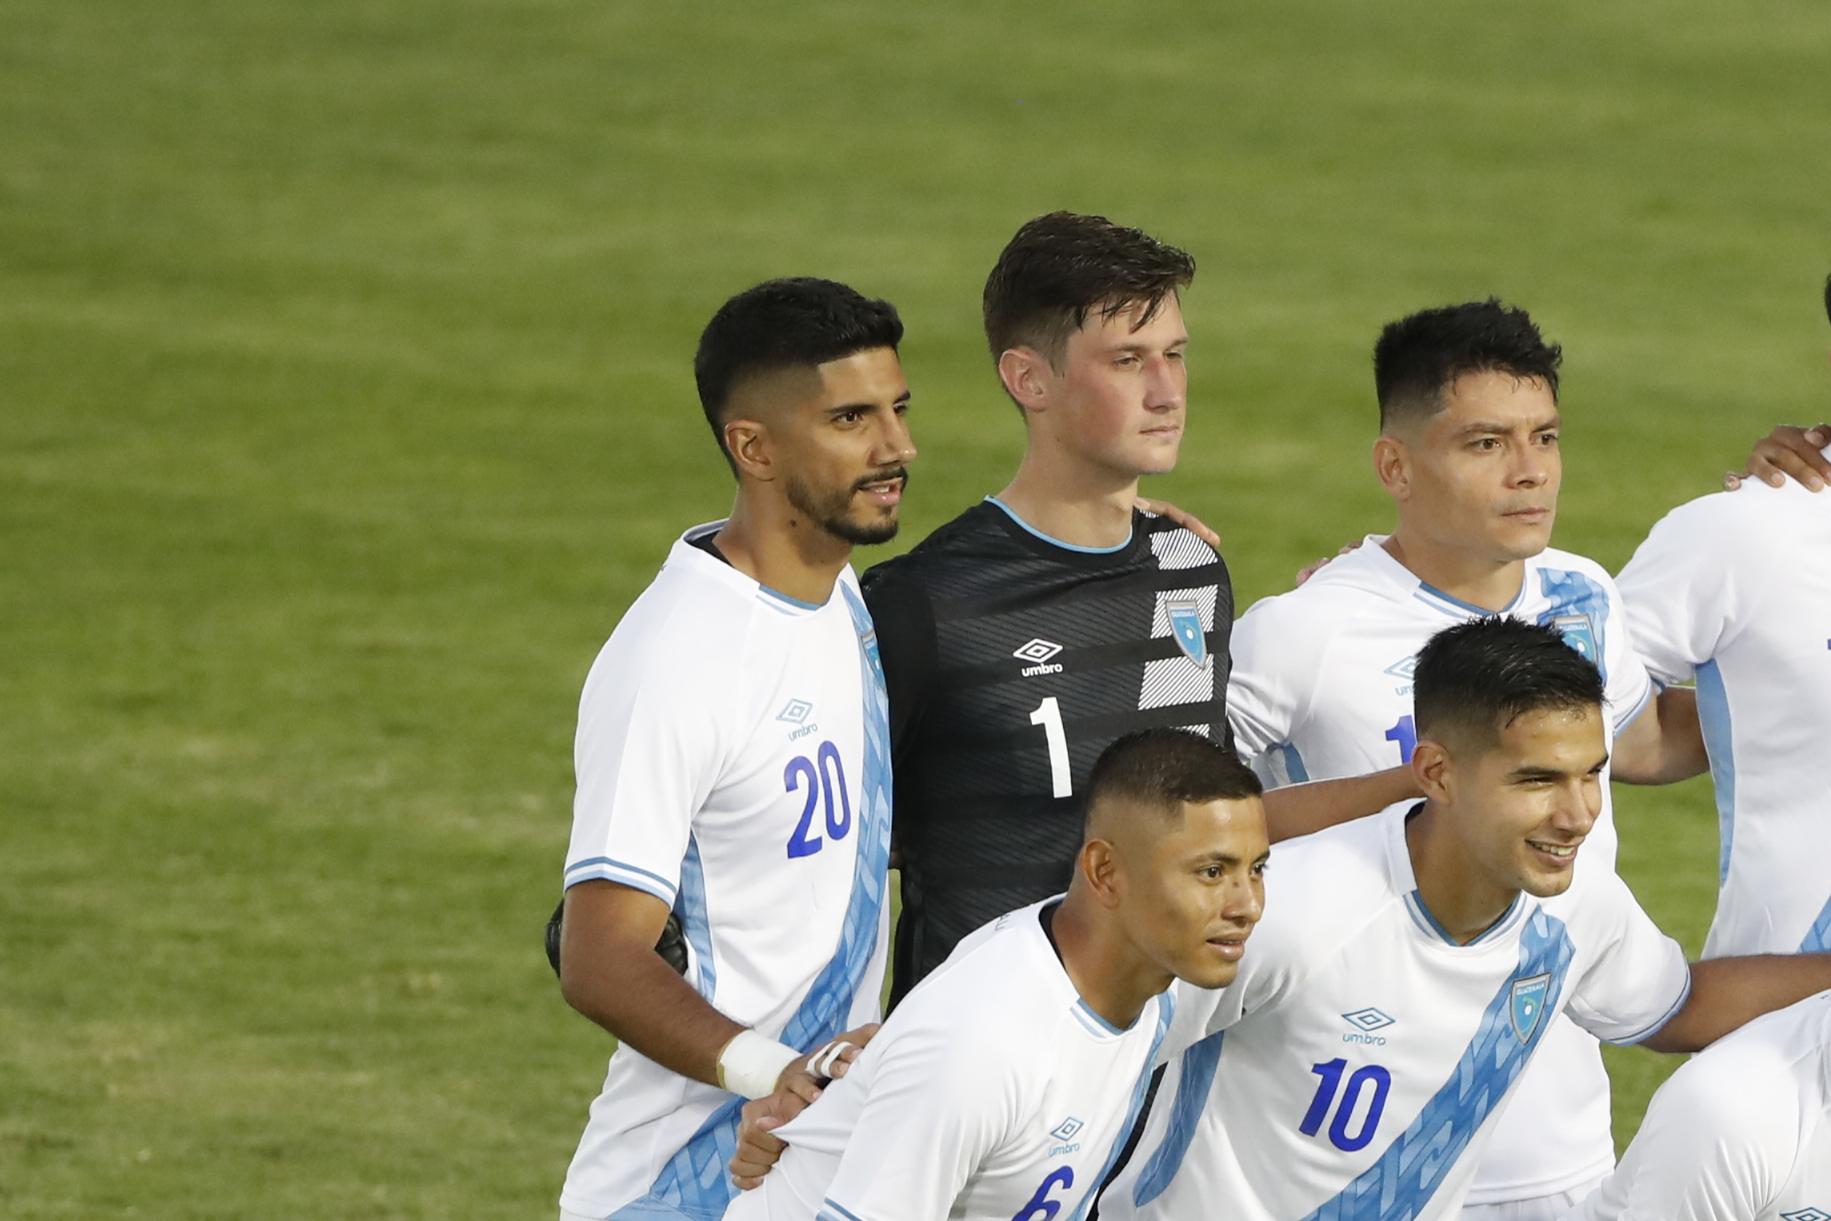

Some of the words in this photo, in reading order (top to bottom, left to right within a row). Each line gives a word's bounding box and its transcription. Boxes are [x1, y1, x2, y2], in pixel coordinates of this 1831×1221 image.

[1021, 662, 1064, 677] umbro
[787, 723, 818, 742] umbro
[1030, 697, 1073, 799] 1
[1385, 715, 1417, 763] 1
[784, 740, 852, 860] 20
[1342, 1033, 1387, 1046] umbro
[1299, 1057, 1391, 1152] 10
[1047, 1142, 1080, 1157] umbro
